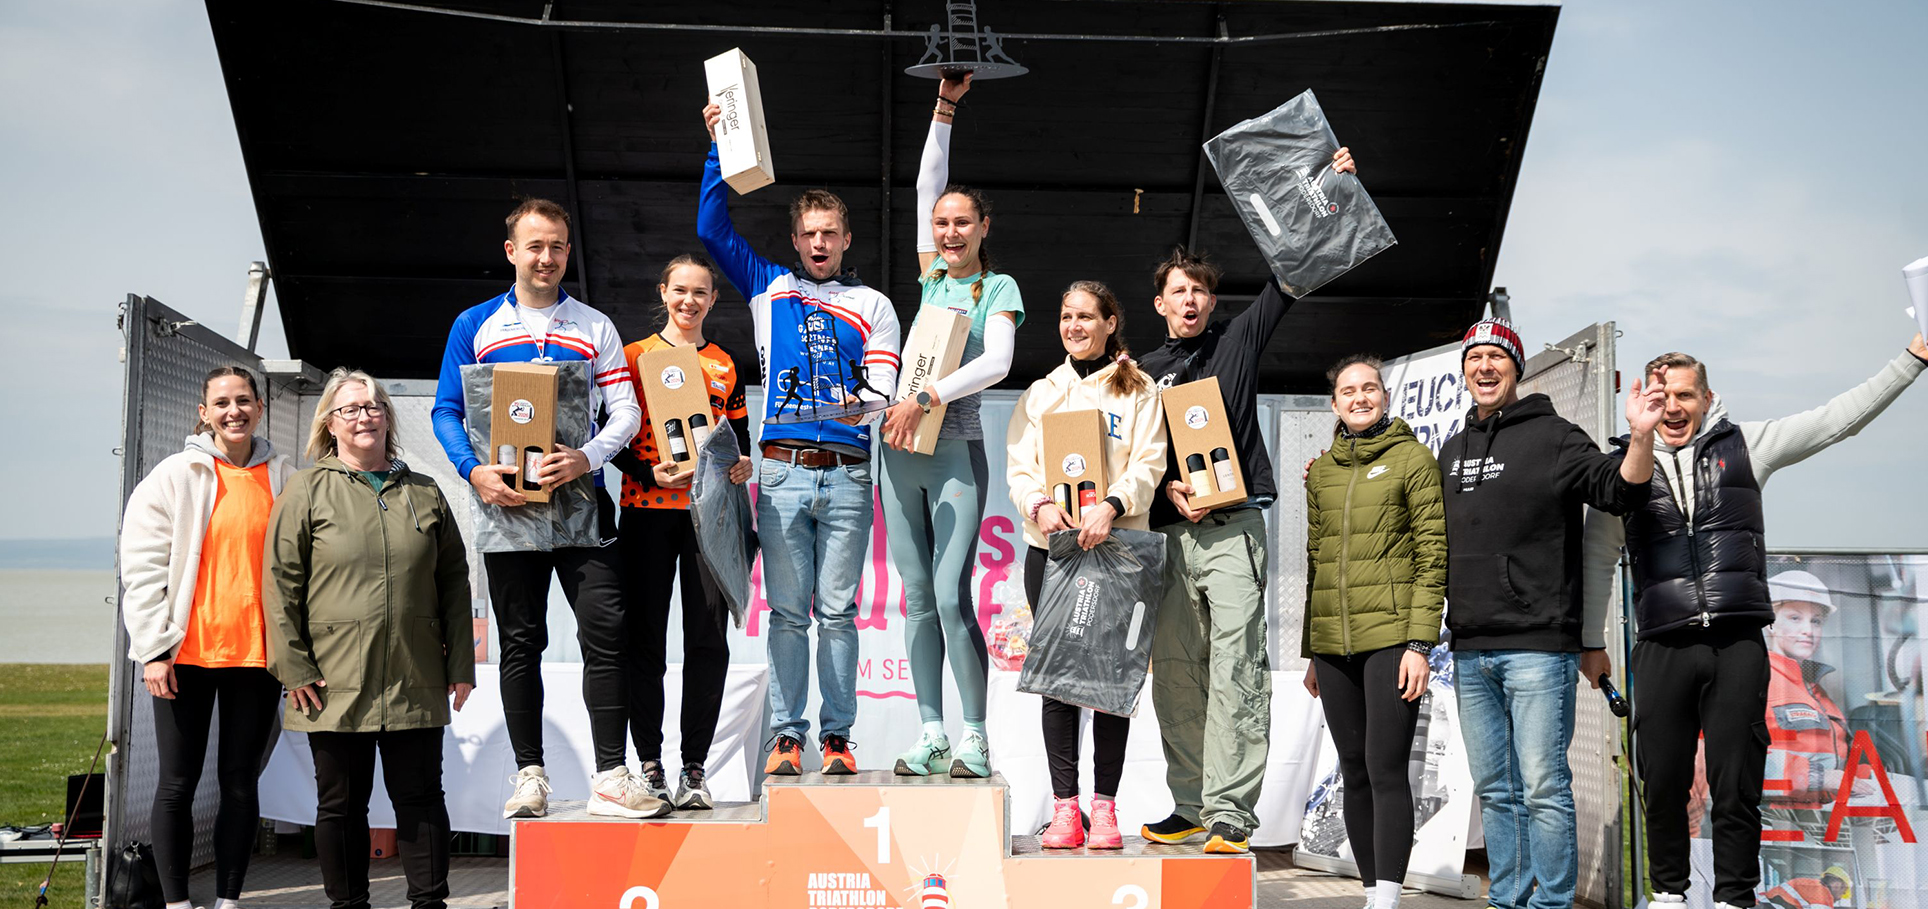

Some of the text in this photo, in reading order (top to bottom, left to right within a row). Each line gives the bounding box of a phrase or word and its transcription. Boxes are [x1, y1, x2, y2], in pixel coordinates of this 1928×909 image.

[1301, 178, 1329, 218] TRIATHLON
[901, 353, 928, 400] ringer
[1073, 589, 1085, 624] AUSTRIA
[1079, 581, 1095, 625] TRIATHLON
[1086, 584, 1100, 626] PODERSDORF
[883, 658, 909, 680] SE
[863, 806, 891, 864] 1
[807, 872, 871, 889] AUSTRIA
[807, 890, 886, 906] TRIATHLON
